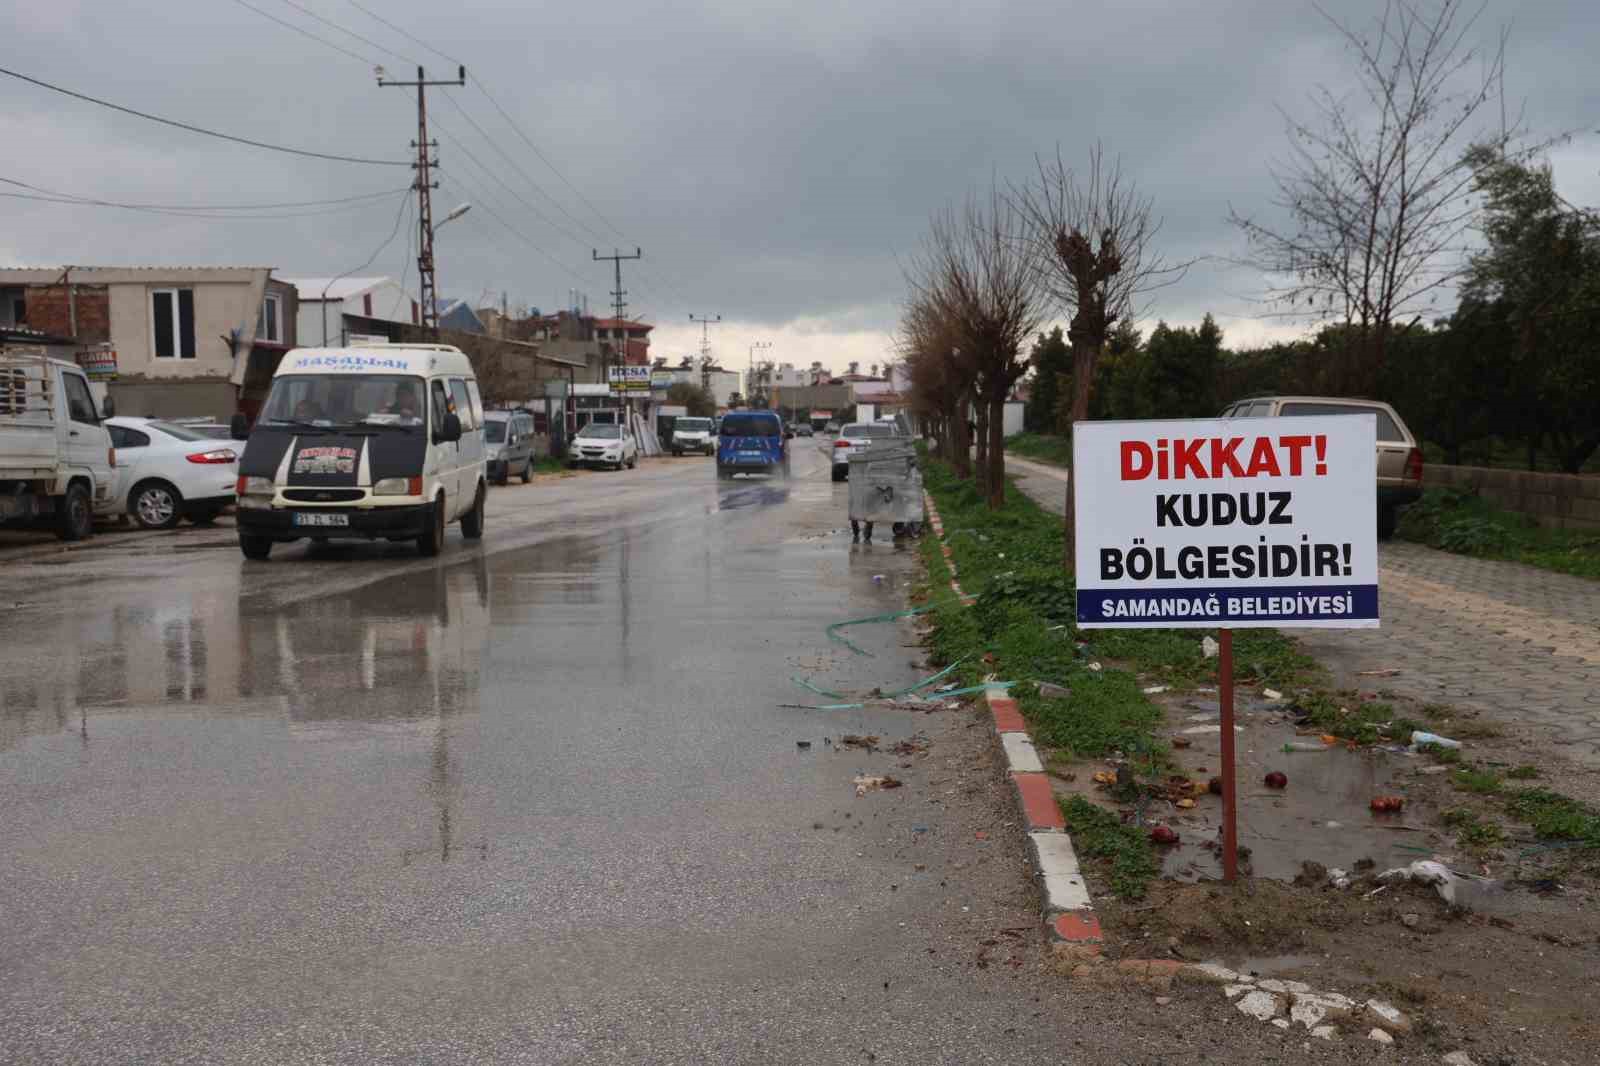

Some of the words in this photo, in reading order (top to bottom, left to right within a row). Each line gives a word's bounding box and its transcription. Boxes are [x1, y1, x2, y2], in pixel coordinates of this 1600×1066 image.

[1156, 491, 1293, 527] KUDUZ
[1100, 536, 1353, 580] BÖLGESİDİR!
[1101, 592, 1220, 618] SAMANDAĞ
[1227, 591, 1354, 616] BELEDİYESİ
